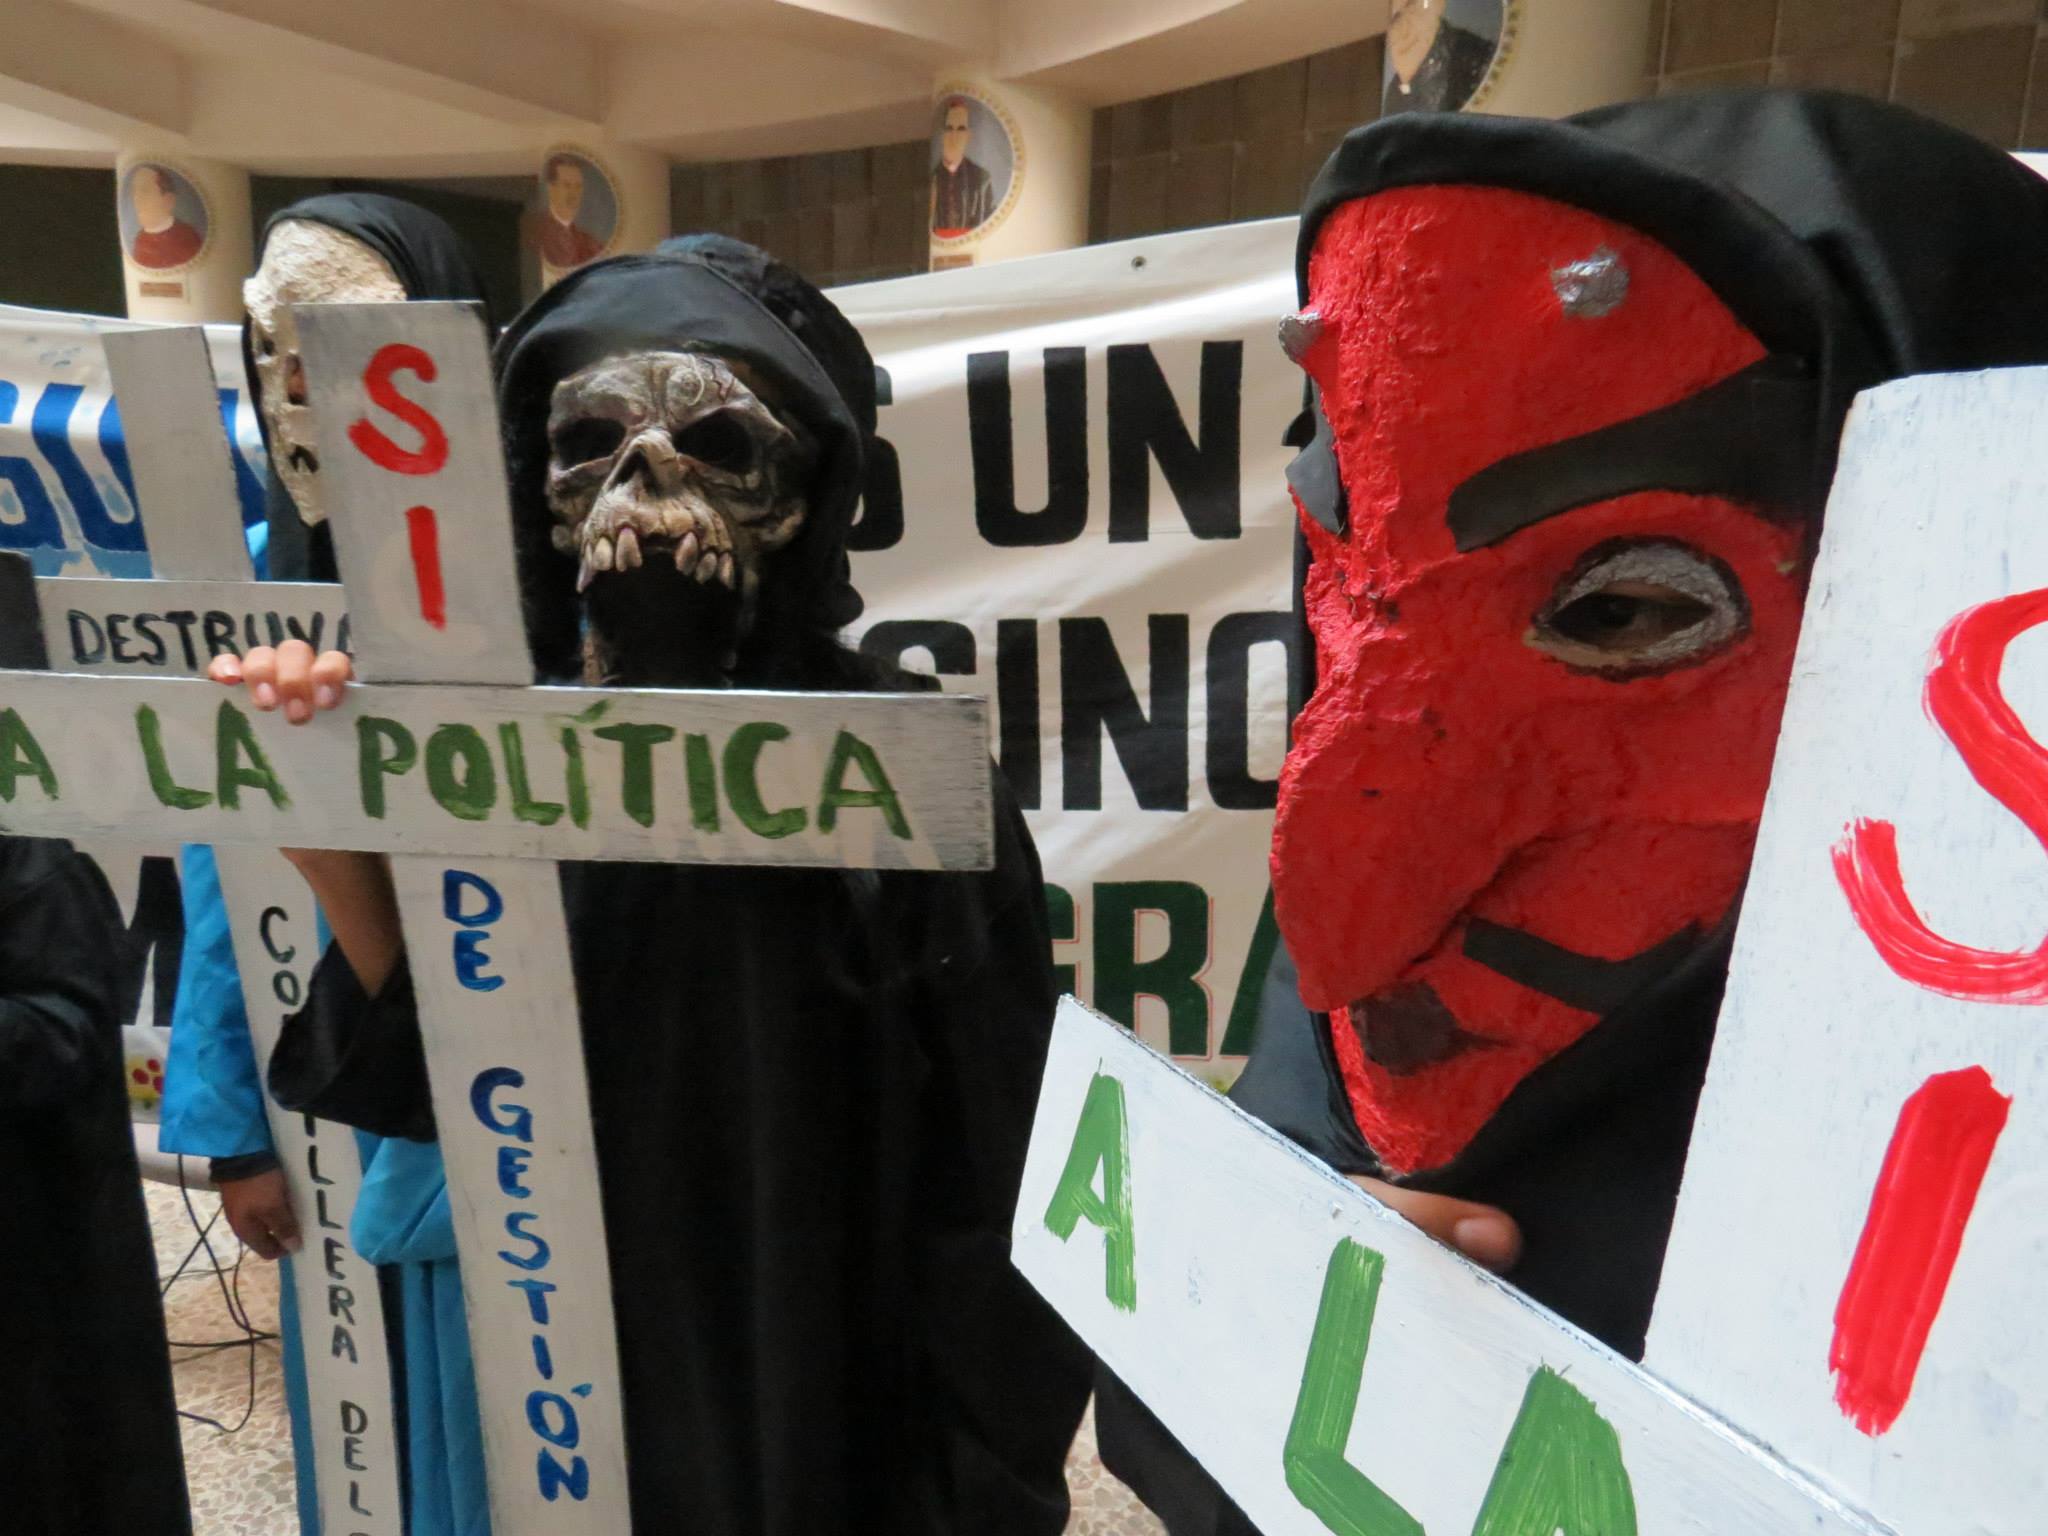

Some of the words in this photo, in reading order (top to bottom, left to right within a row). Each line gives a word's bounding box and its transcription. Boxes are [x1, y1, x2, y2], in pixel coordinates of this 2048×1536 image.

[348, 343, 449, 631] SI
[967, 339, 1243, 547] UN
[0, 705, 59, 801] A
[135, 699, 291, 812] LA
[356, 699, 912, 840] POLÍTICA
[443, 868, 504, 992] DE
[1829, 587, 2048, 1438] SI
[470, 1066, 592, 1502] GESTIÓN
[1044, 1060, 1136, 1314] A
[340, 1400, 373, 1516] DEL
